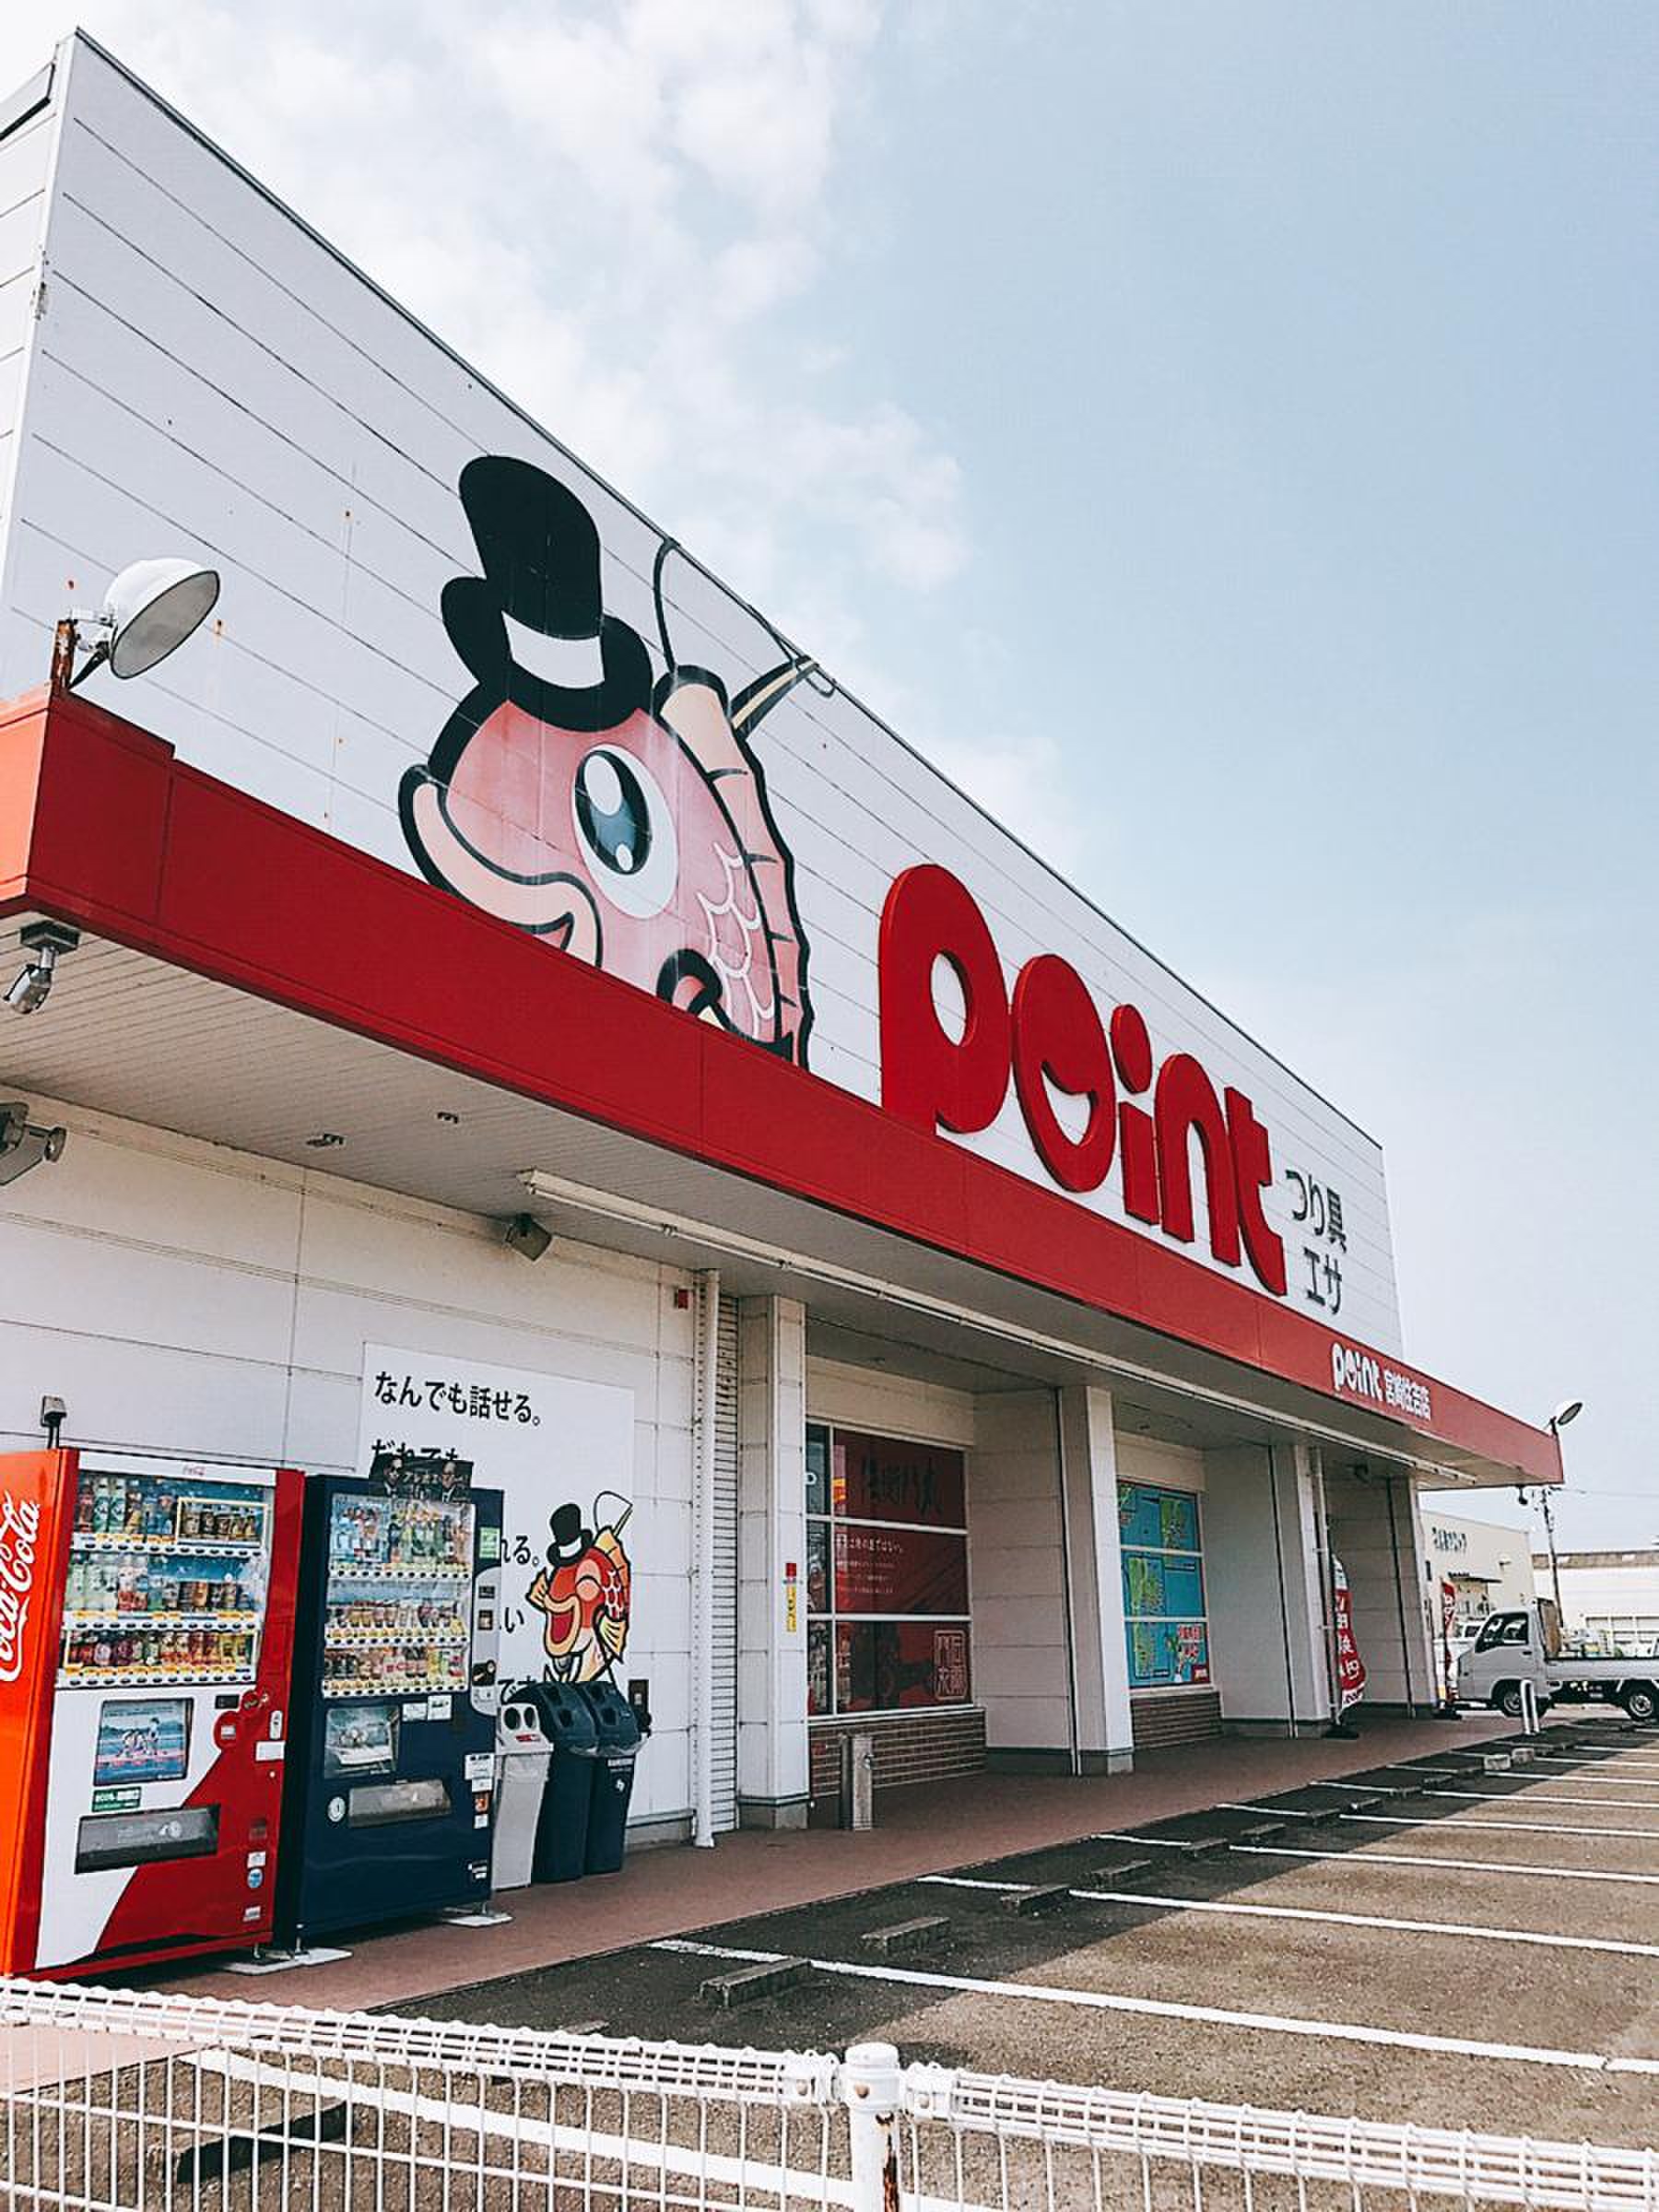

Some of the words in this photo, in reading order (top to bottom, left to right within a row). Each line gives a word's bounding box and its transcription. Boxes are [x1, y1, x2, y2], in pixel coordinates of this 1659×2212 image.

[1285, 1169, 1347, 1254] つり具
[1304, 1246, 1342, 1315] エサ
[374, 1371, 541, 1426] なんでも話せる。
